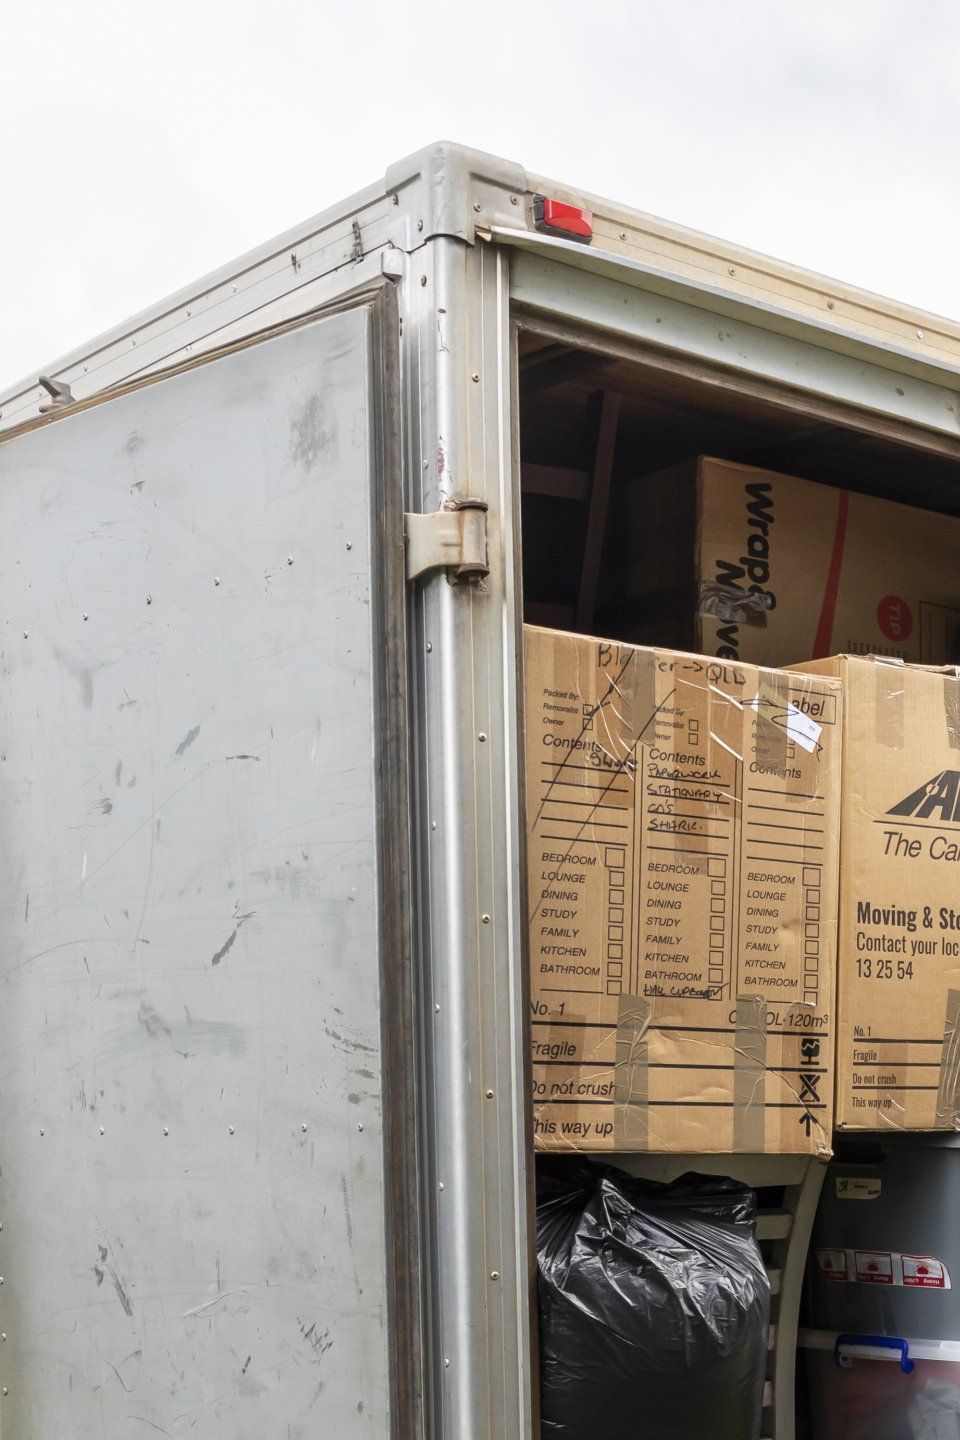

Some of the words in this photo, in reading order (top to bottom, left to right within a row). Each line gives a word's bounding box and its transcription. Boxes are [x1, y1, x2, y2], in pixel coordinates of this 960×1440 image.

[888, 603, 902, 635] TIP
[543, 688, 568, 698] Packed
[542, 702, 579, 714] Removalist
[791, 697, 826, 717] abel
[542, 717, 565, 727] Owner
[655, 719, 685, 730] emovalist
[655, 732, 672, 742] wner
[542, 734, 603, 753] Contents
[649, 748, 706, 767] Contents
[883, 831, 922, 858] The
[541, 852, 597, 866] BEDROOM
[647, 862, 700, 876] BEDROOM
[541, 871, 587, 883] LOUNGE
[747, 872, 796, 885] BEDROOM
[647, 881, 690, 893] LOUNGE
[541, 889, 579, 901] DINING
[746, 890, 787, 902] LOUNGE
[646, 899, 682, 910] DINING
[540, 908, 578, 919] STUDY
[746, 907, 779, 918] DINING
[857, 901, 918, 932] Moving
[922, 906, 934, 928] &
[646, 916, 681, 927] STUDY
[540, 927, 580, 938] FAMILY
[745, 924, 778, 935] STUDY
[645, 934, 683, 945] FAMILY
[856, 931, 907, 953] Contact
[910, 938, 938, 957] your
[540, 945, 587, 957] KITCHEN
[745, 941, 780, 952] FAMILY
[644, 952, 690, 964] KITCHEN
[540, 963, 601, 976] BATHROOM
[744, 959, 787, 970] KITCHEN
[855, 959, 872, 978] 13
[876, 960, 893, 979] 25
[896, 960, 913, 980] 54
[644, 970, 703, 982] BATHROOM
[744, 976, 798, 988] BATHROOM
[531, 1001, 551, 1015] No.
[557, 1003, 565, 1015] 1
[853, 1026, 866, 1037] No.
[867, 1026, 871, 1037] 1
[531, 1040, 576, 1057] Fragile
[853, 1049, 878, 1062] Fragile
[852, 1074, 862, 1084] Do
[863, 1074, 876, 1085] not
[876, 1074, 897, 1085] crush
[550, 1082, 574, 1095] not
[577, 1081, 616, 1096] crush
[852, 1097, 866, 1108] This
[867, 1099, 882, 1110] way
[883, 1099, 892, 1109] up
[561, 1123, 591, 1138] way
[595, 1123, 613, 1139] up
